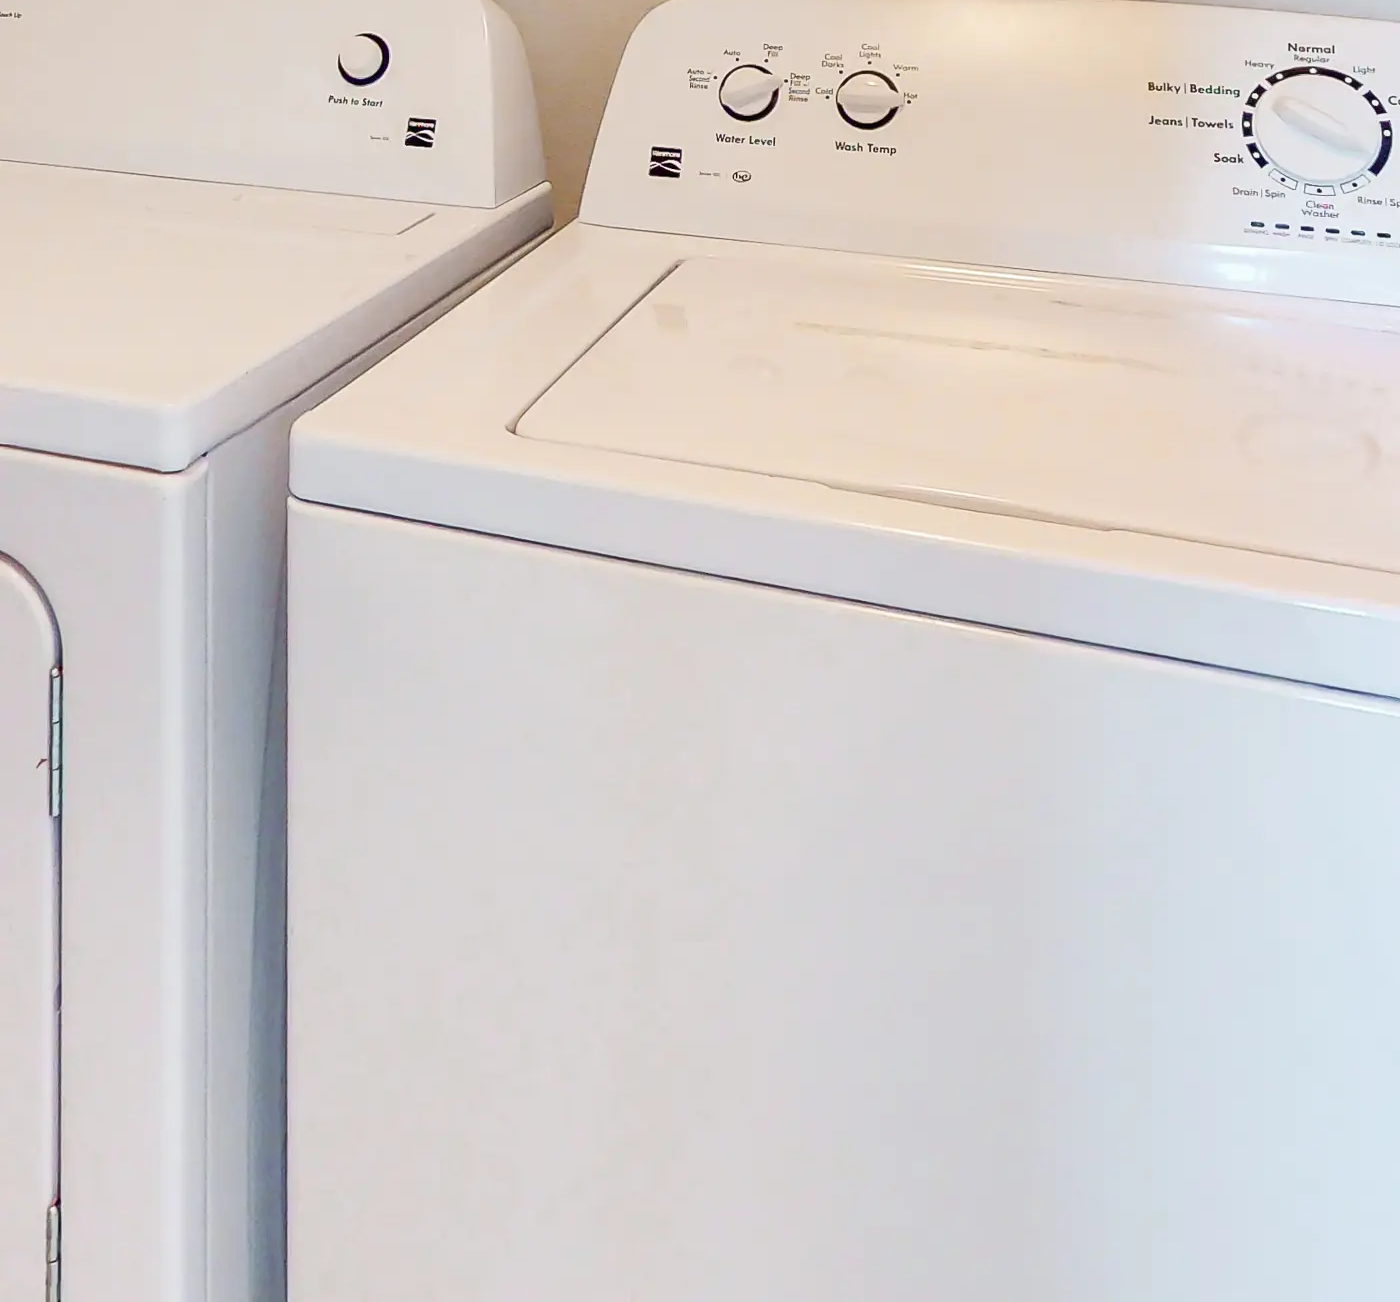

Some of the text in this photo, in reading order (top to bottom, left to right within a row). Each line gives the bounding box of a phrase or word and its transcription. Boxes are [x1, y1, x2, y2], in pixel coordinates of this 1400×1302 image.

[763, 43, 783, 51] Deep
[1288, 42, 1336, 54] Normal
[1293, 55, 1330, 64] Regular
[1244, 60, 1275, 70] Heavy
[1352, 66, 1376, 75] Light
[790, 73, 811, 81] Deep
[815, 87, 834, 95] Cold
[1148, 82, 1241, 98] Bulky Bedding
[328, 95, 383, 107] Push to Start
[1148, 116, 1234, 130] Jeans Towels
[716, 133, 776, 146] Water Level
[835, 141, 897, 156] Wash Temp
[1213, 153, 1244, 164] Soak
[1232, 188, 1286, 199] Drain Spin
[1305, 201, 1334, 210] Clean
[1357, 196, 1382, 206] Rinse
[1301, 209, 1340, 219] Washer
